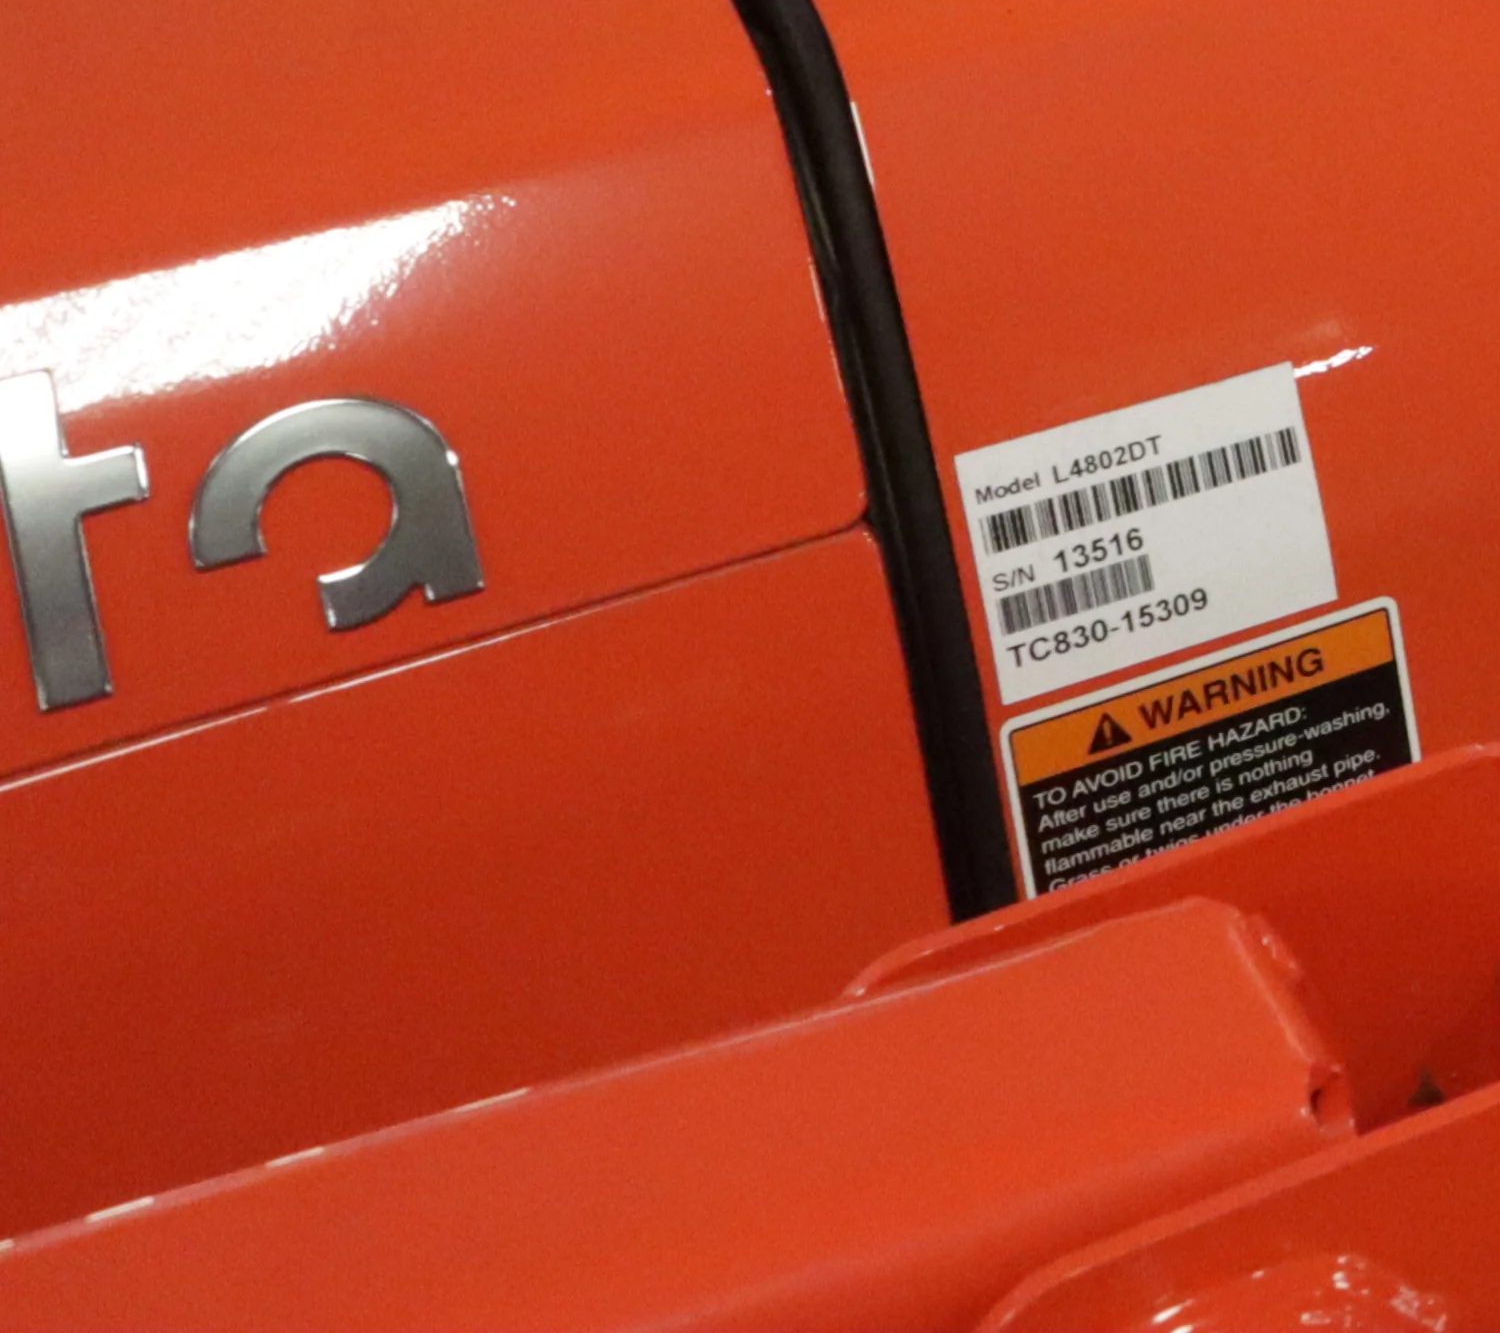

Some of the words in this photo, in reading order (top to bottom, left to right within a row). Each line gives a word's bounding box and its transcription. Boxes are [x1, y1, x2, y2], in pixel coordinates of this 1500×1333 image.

[975, 472, 1041, 505] Model
[1052, 435, 1162, 483] L4802DT
[992, 564, 1036, 594] S/N
[1053, 529, 1144, 574] 13516
[1007, 588, 1208, 667] TC830-15309
[1139, 647, 1324, 730] WARNING
[1032, 787, 1066, 809] TO
[1070, 761, 1143, 801] AVOID
[1148, 741, 1201, 777] FIRE
[1207, 706, 1308, 761] HAZARD:
[1038, 804, 1088, 833] After
[1093, 797, 1128, 816] use
[1132, 764, 1204, 807] and/or
[1209, 701, 1391, 783] pressure-washing,
[1041, 823, 1099, 854] make
[1104, 809, 1152, 837] sure
[1157, 783, 1208, 822] there
[1213, 779, 1228, 797] is
[1231, 747, 1315, 798] nothing
[1044, 829, 1152, 878] flammable
[1158, 810, 1201, 837] near
[1206, 789, 1243, 819] the
[1248, 767, 1324, 811] exhaust
[1329, 747, 1381, 789] pipe.
[1049, 864, 1112, 894] Grass
